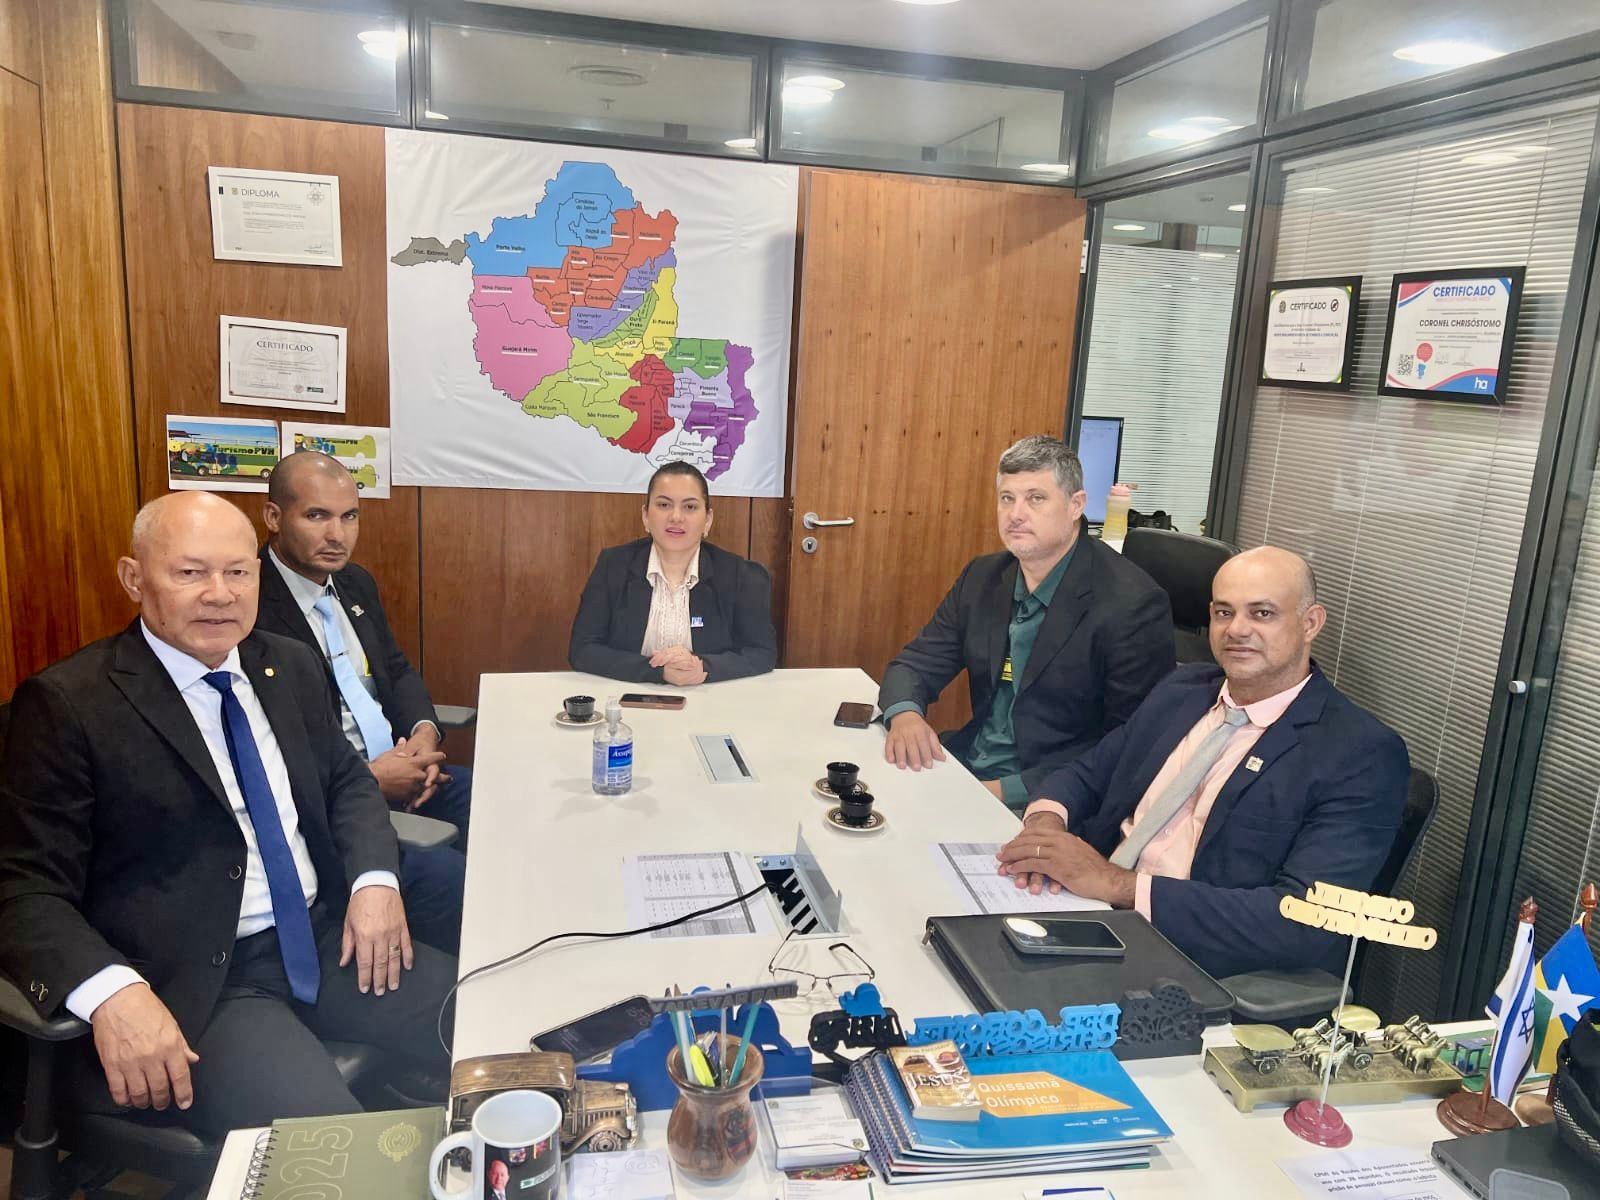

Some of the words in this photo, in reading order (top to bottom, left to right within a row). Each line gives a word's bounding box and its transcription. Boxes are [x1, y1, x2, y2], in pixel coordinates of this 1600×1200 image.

[241, 188, 280, 198] DIPLOMA
[1433, 285, 1496, 297] CERTIFICADO
[1290, 302, 1327, 311] CERTIFICADO
[1419, 319, 1450, 327] CORONEL
[1450, 317, 1502, 327] CHRISÓSTOMO
[257, 340, 313, 352] CERTIFICADO
[905, 1067, 970, 1089] JESUS
[978, 1079, 1061, 1093] Quissamã
[986, 1094, 1060, 1107] Olímpico
